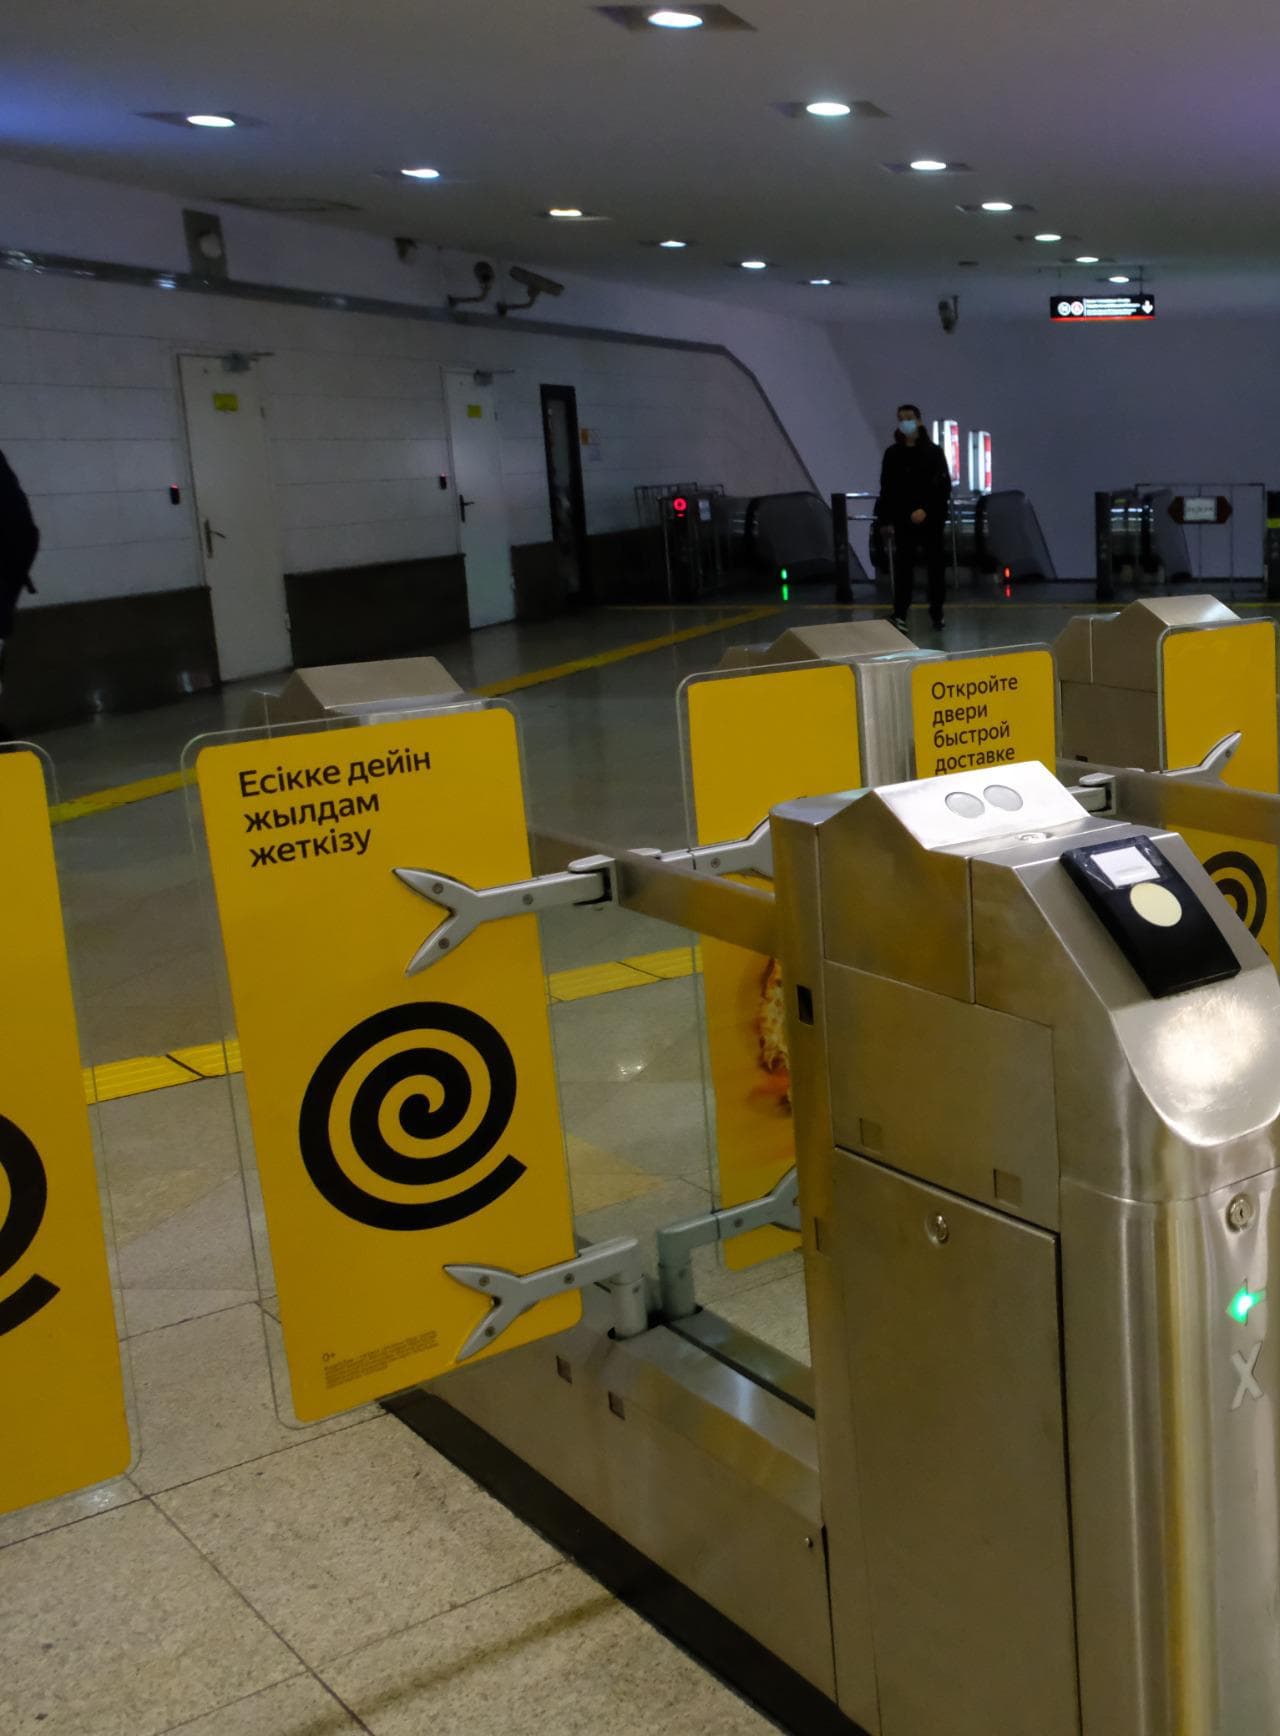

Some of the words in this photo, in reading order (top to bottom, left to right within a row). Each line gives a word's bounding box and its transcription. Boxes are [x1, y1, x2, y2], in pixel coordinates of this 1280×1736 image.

[931, 675, 1018, 700] Откройте
[932, 704, 988, 728] двери
[933, 720, 1010, 748] быстрой
[238, 764, 341, 797] Есікке
[347, 748, 431, 786] дейін
[935, 747, 1015, 775] доставке
[244, 793, 380, 833] жылдам
[249, 828, 372, 868] жеткізу
